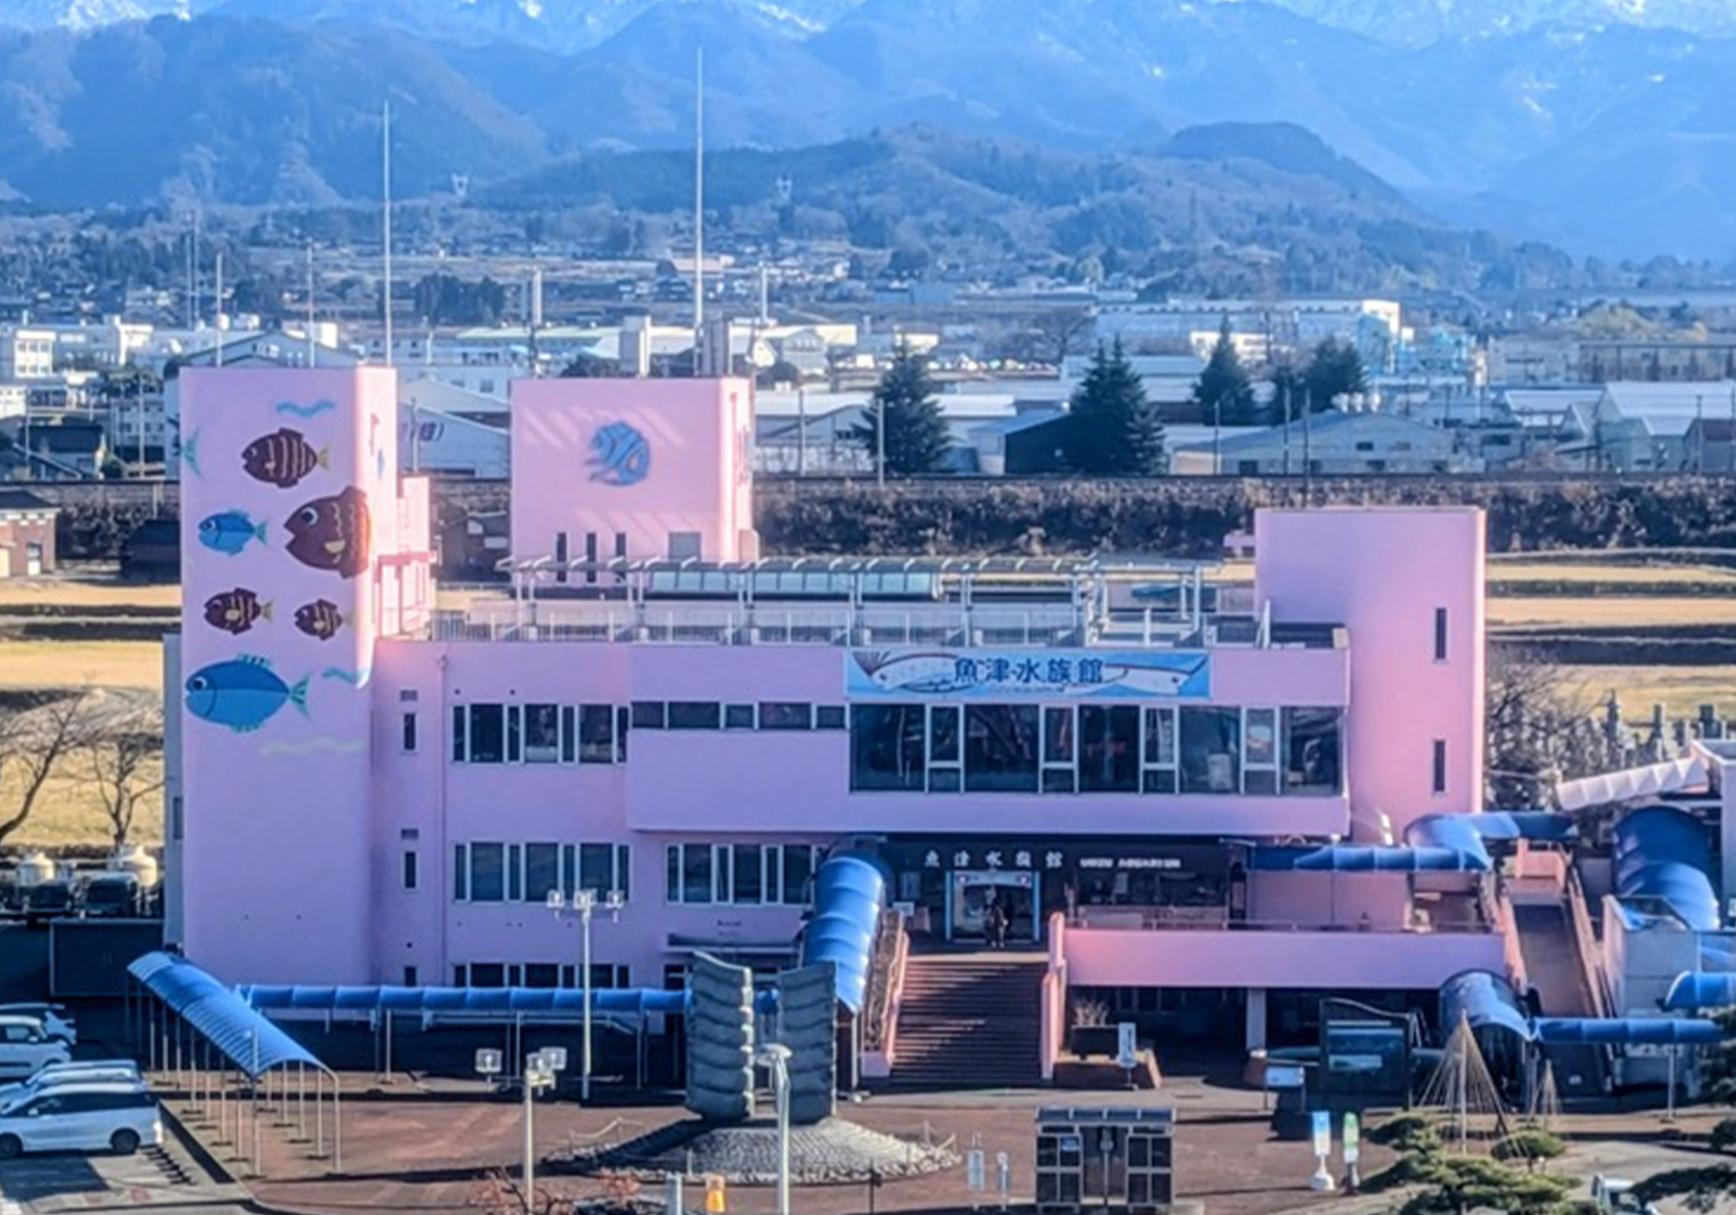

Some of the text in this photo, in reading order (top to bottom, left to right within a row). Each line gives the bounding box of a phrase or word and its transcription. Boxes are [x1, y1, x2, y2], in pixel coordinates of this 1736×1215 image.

[955, 657, 1103, 683] 魚津水族館
